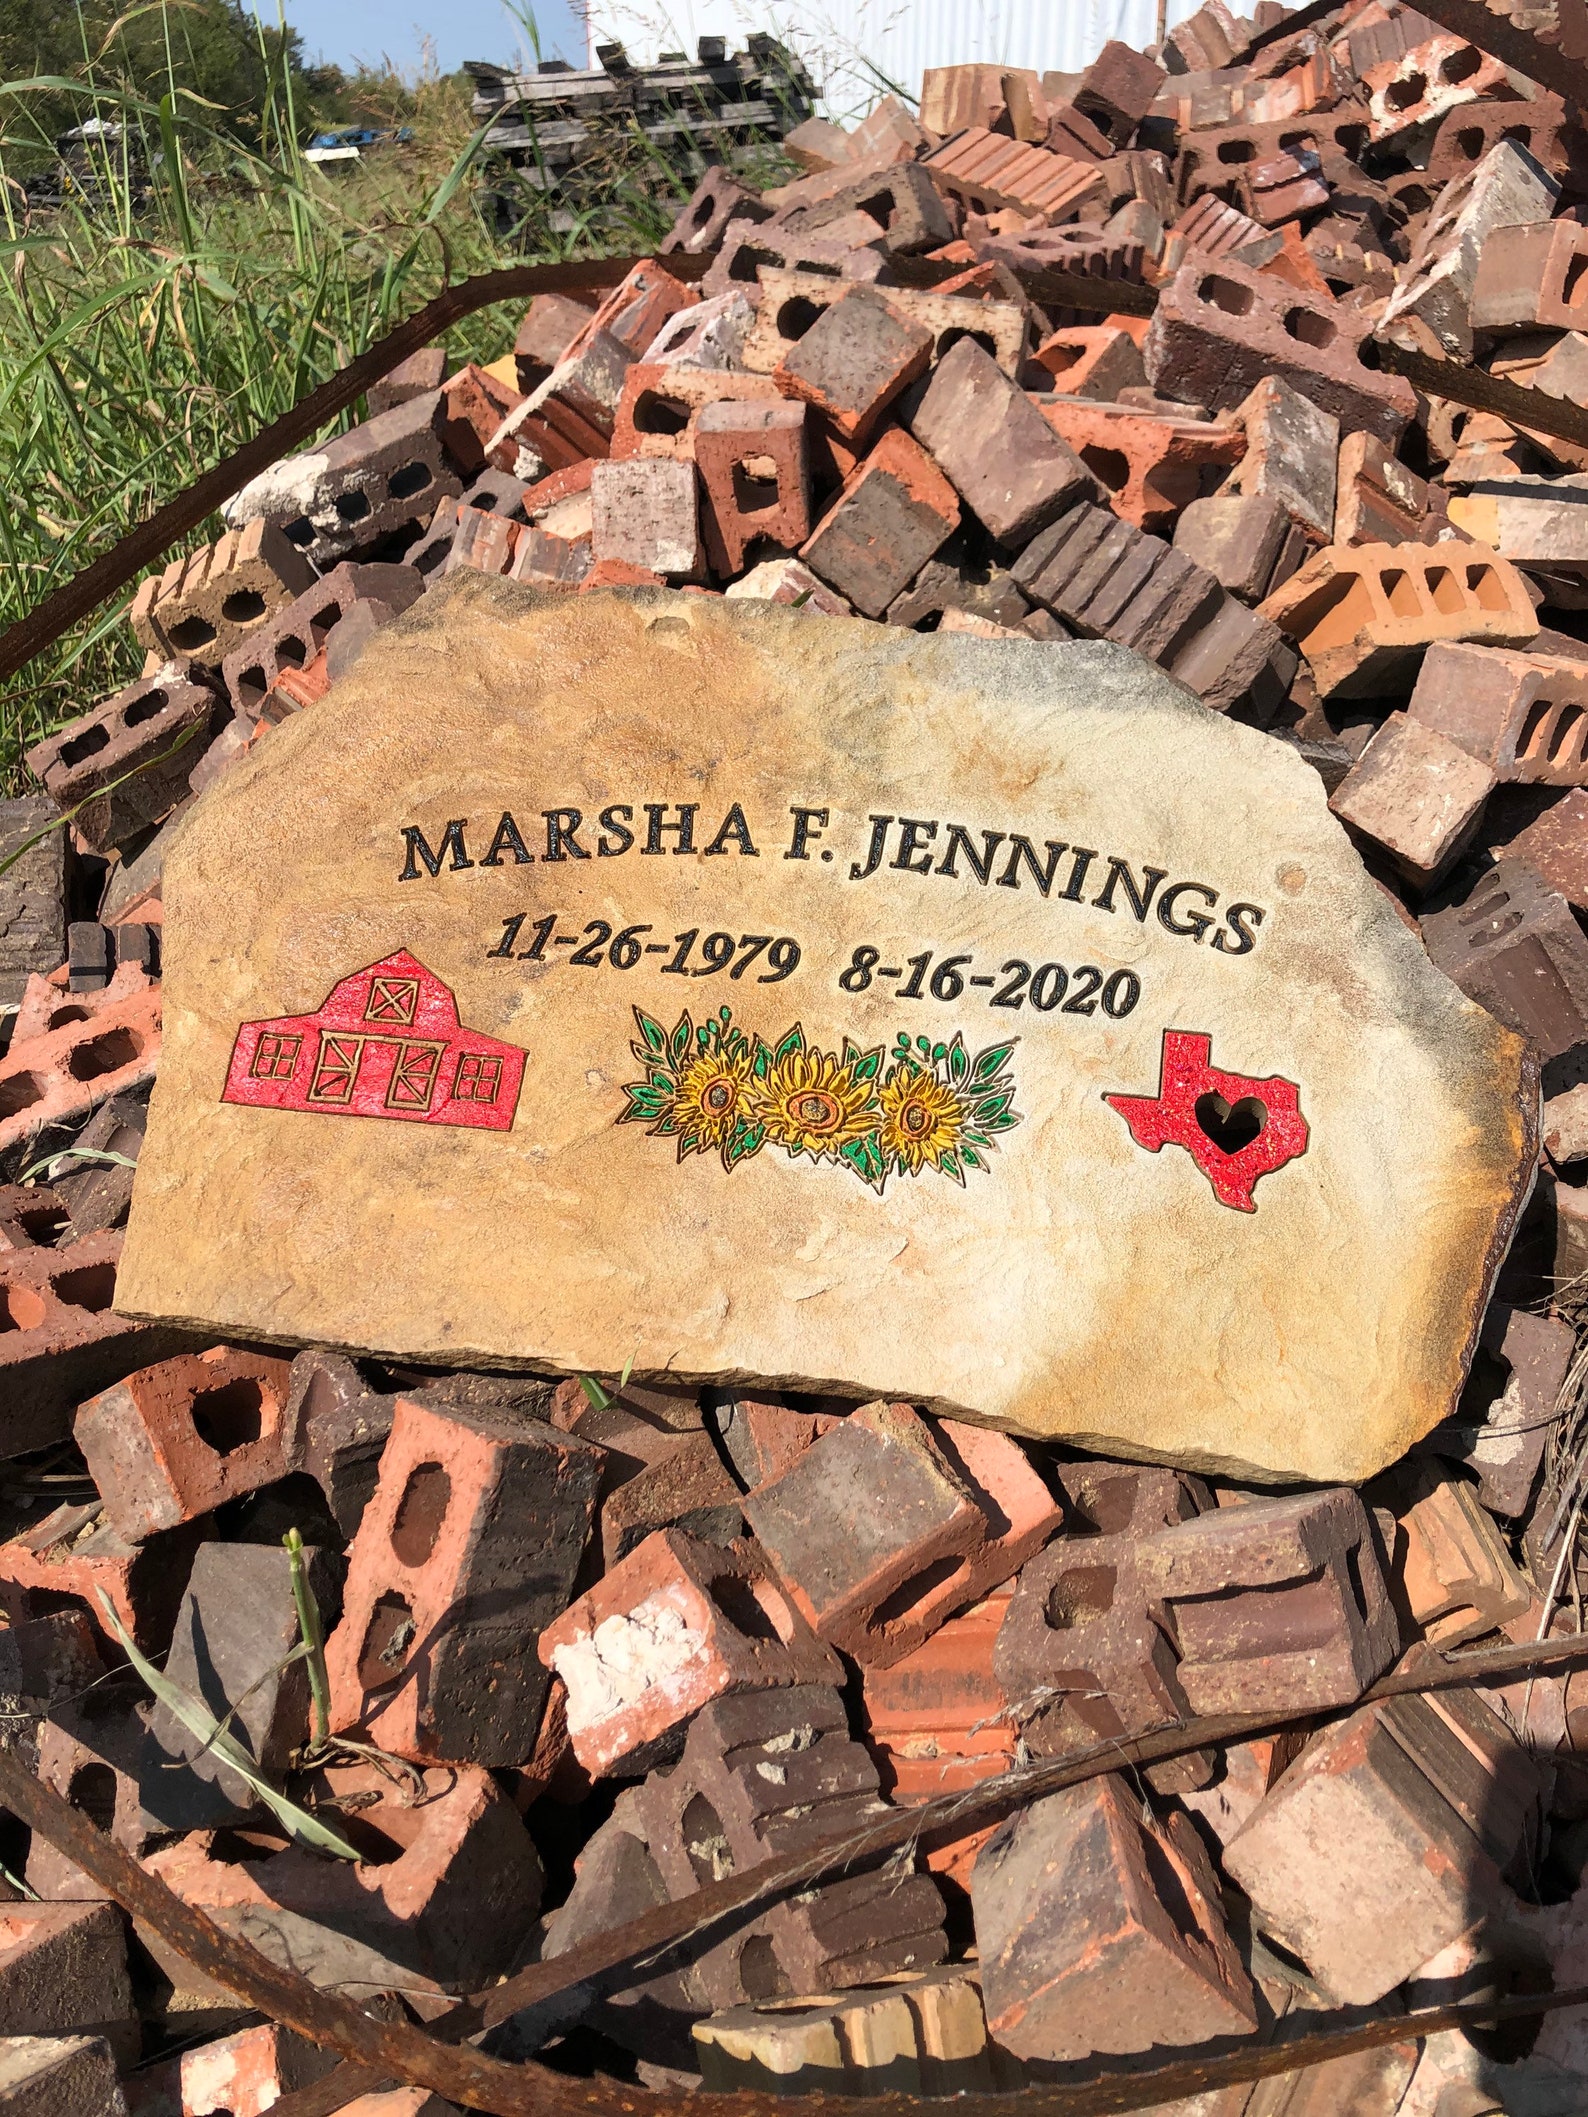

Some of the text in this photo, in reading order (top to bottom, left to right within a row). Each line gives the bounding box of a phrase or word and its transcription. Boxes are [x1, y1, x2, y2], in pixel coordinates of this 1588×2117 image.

[397, 802, 1266, 956] MARSHA F. JENNINGS
[486, 911, 1142, 1020] 11-26-1979 8-16-2020
